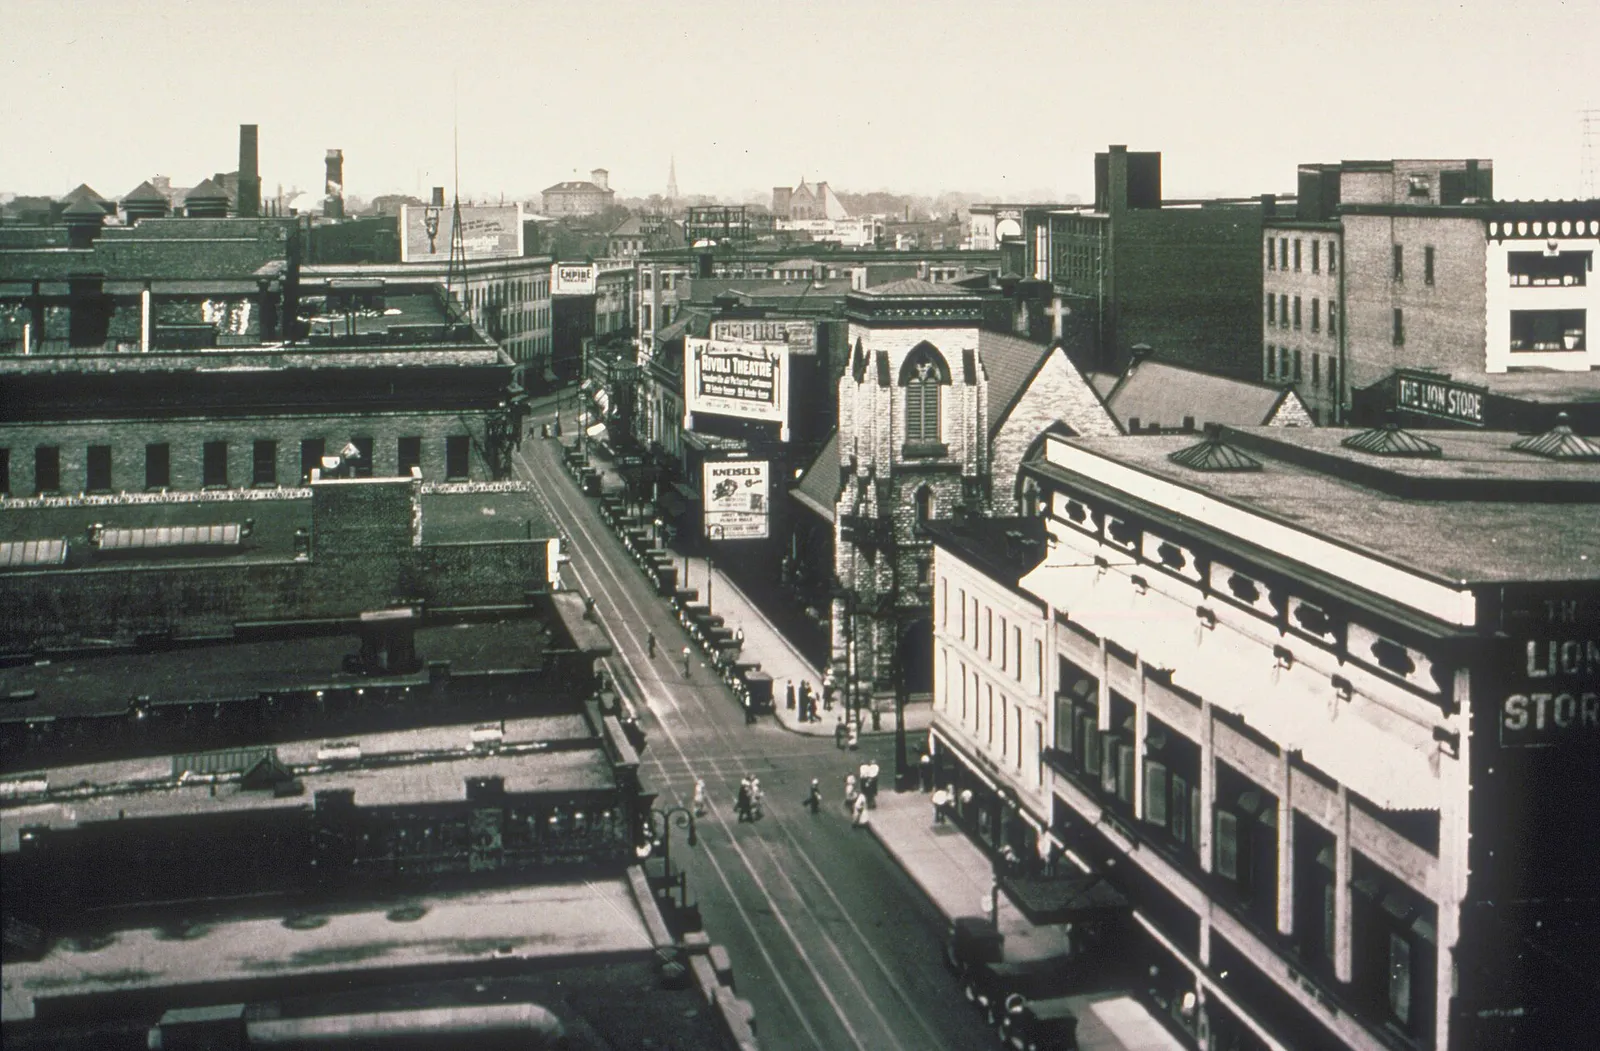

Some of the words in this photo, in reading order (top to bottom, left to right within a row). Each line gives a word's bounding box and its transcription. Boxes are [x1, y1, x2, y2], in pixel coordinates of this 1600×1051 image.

[561, 269, 591, 279] EMPIRE
[716, 323, 786, 341] EMPIRE
[702, 354, 731, 373] RIVOLI
[732, 357, 772, 378] THEATRE
[1400, 379, 1419, 407] THE
[1421, 383, 1446, 411] LION
[1447, 388, 1482, 420] STORE
[712, 466, 761, 477] KNEISEL'S
[1543, 600, 1577, 624] TH
[1527, 640, 1600, 678] LION
